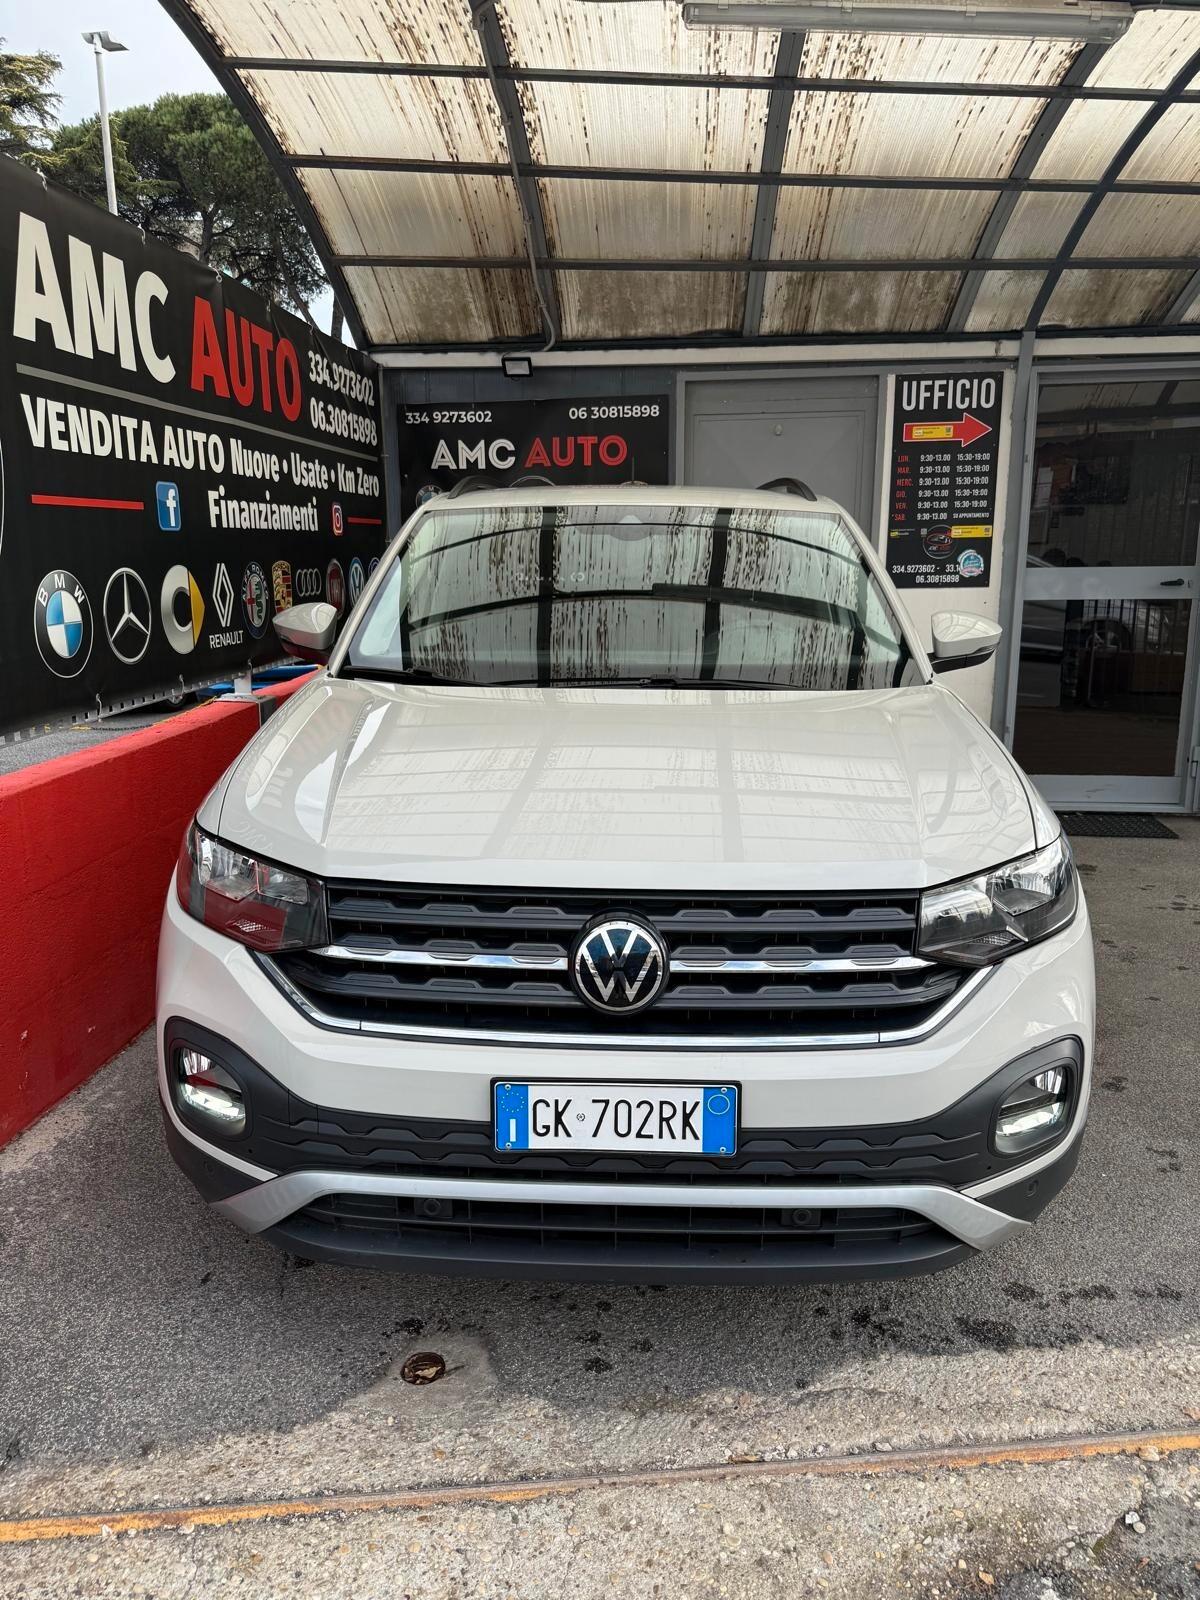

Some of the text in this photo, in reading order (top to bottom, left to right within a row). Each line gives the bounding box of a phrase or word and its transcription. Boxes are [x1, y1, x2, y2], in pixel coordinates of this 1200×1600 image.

[13, 211, 303, 422] AMC AUTO
[308, 350, 375, 406] 334.9273602
[902, 378, 996, 410] UFFICIO
[310, 397, 378, 446] 06.30815898
[405, 410, 492, 424] 334 9273602
[569, 405, 660, 419] 06 30815898
[20, 393, 380, 497] VENDITA AUTO Nuove Usate Km Zero
[430, 434, 628, 469] AMC AUTO
[207, 485, 319, 532] Finanziamenti
[892, 564, 935, 573] 334.9273602
[915, 574, 960, 583] 06.30815898
[37, 573, 86, 607] BMW
[209, 630, 244, 649] RENAULT
[532, 1098, 700, 1141] GK 702RK
